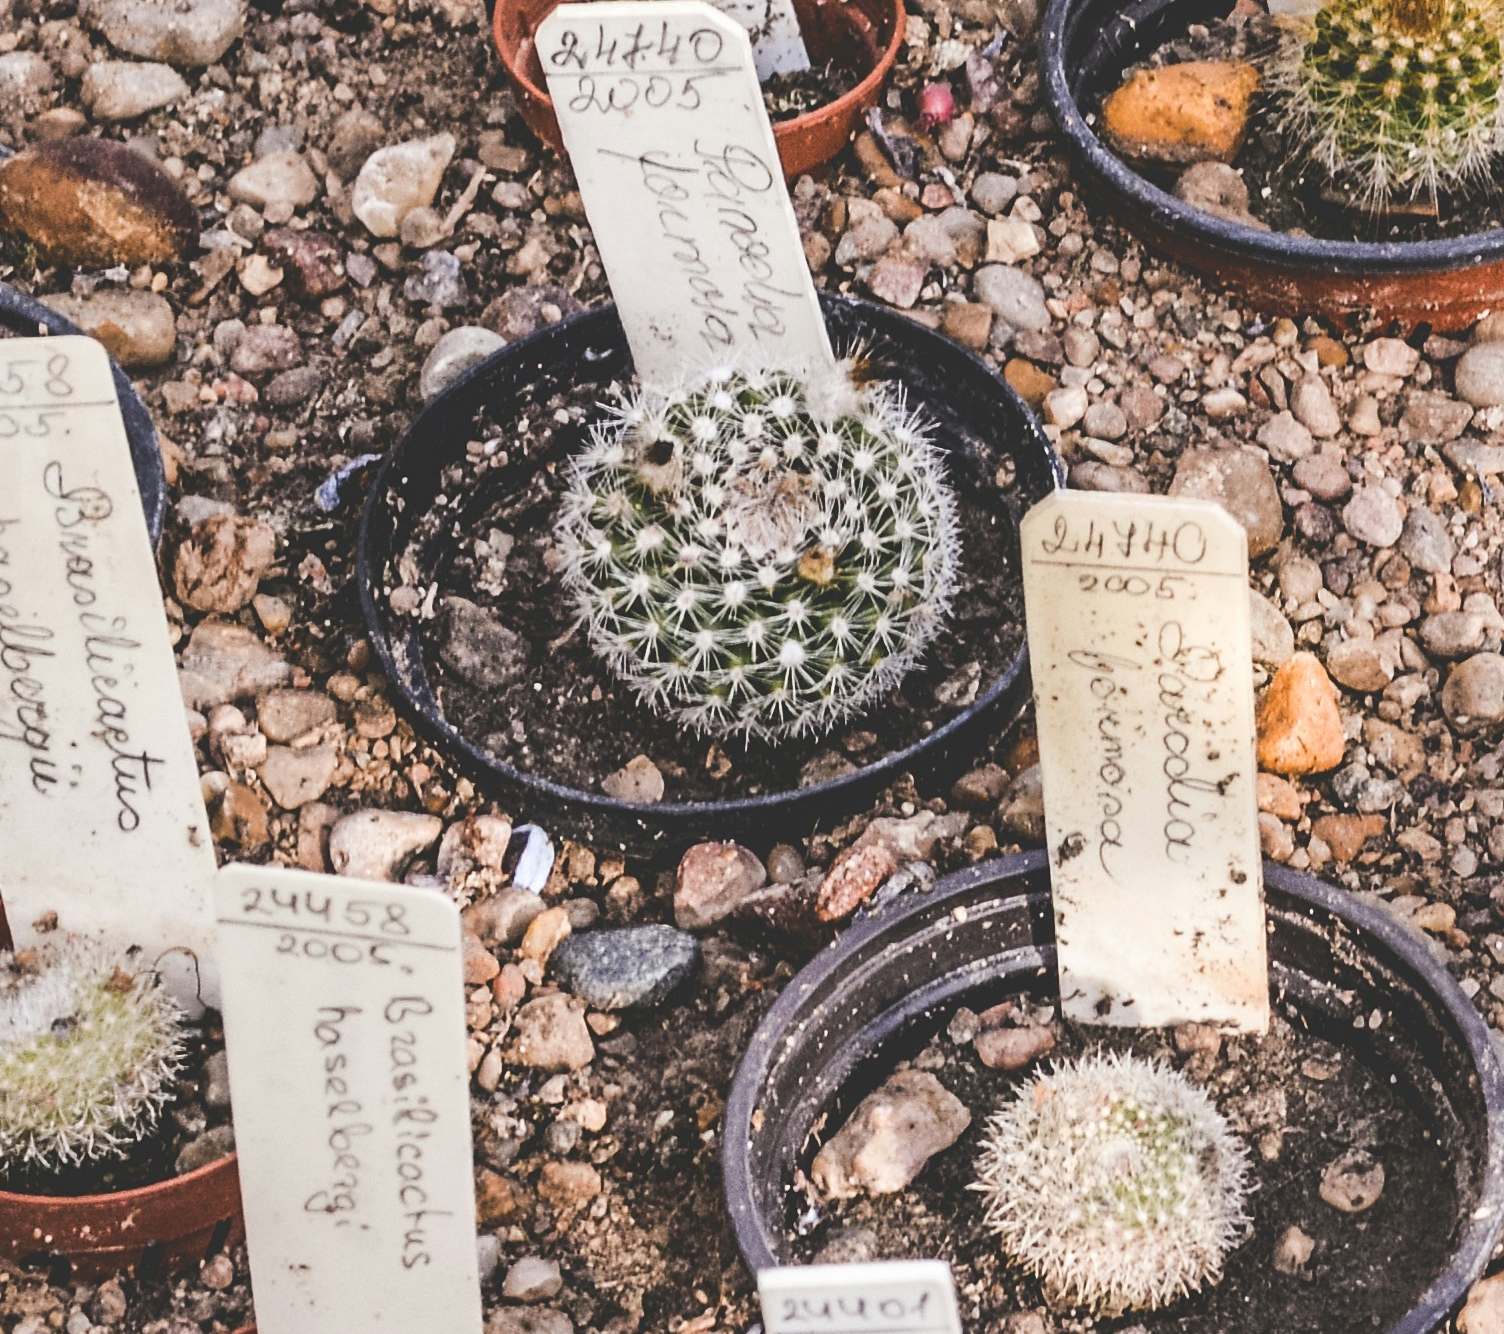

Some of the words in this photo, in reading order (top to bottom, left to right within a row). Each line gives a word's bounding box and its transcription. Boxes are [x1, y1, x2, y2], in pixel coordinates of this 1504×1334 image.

[596, 146, 740, 355] formosa
[692, 137, 806, 343] Parodia
[42, 459, 166, 835] Brasilicactus
[1152, 610, 1226, 865] Parodia
[1065, 647, 1153, 884] formosa
[240, 887, 412, 938] 24458
[781, 1289, 933, 1325] 24401
